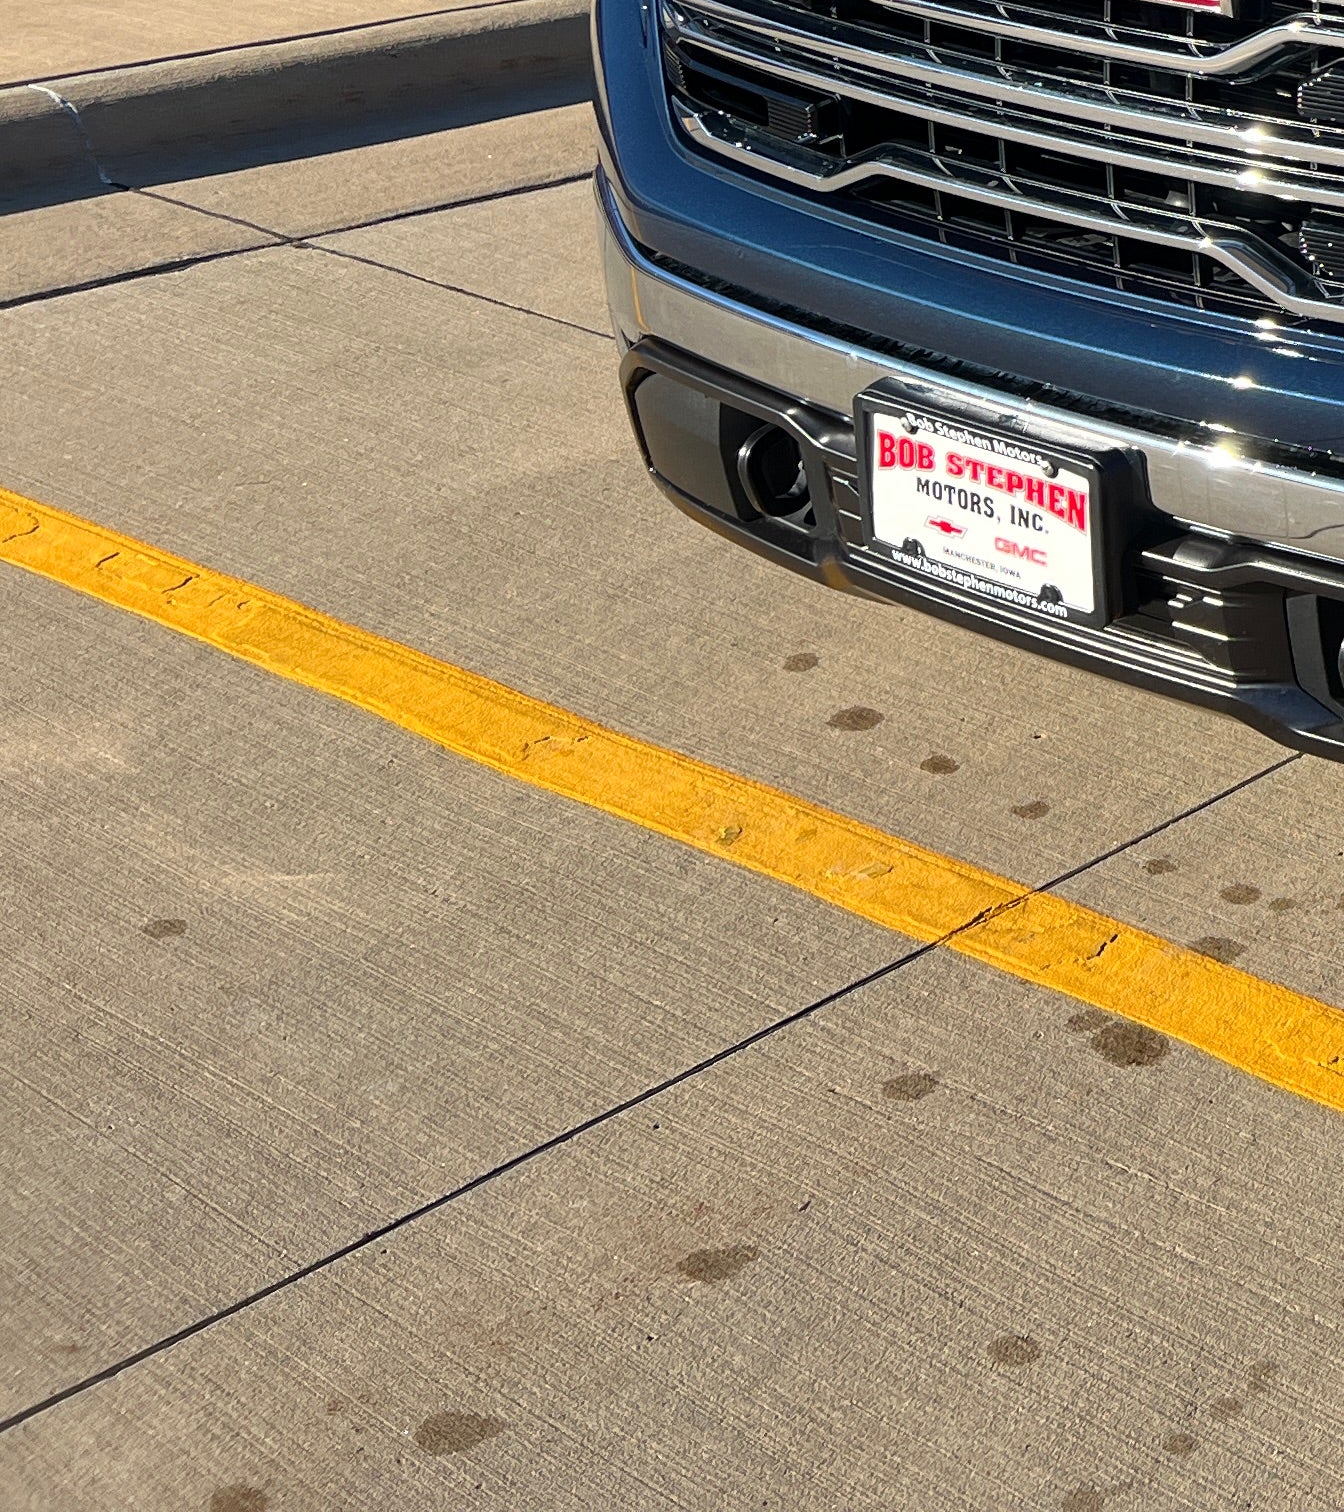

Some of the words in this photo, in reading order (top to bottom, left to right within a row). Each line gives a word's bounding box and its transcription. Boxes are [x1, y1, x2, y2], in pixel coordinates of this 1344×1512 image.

[934, 421, 993, 451] Stephen
[992, 439, 1043, 466] Motors
[877, 429, 936, 472] BOB
[945, 451, 1089, 536] STEPHEN
[915, 476, 1001, 524] MOTORS,
[1010, 504, 1050, 535] INC.
[994, 537, 1048, 567] GMC
[1000, 566, 1022, 580] IOWA
[891, 548, 1068, 618] www.bobstephenmotors.com
